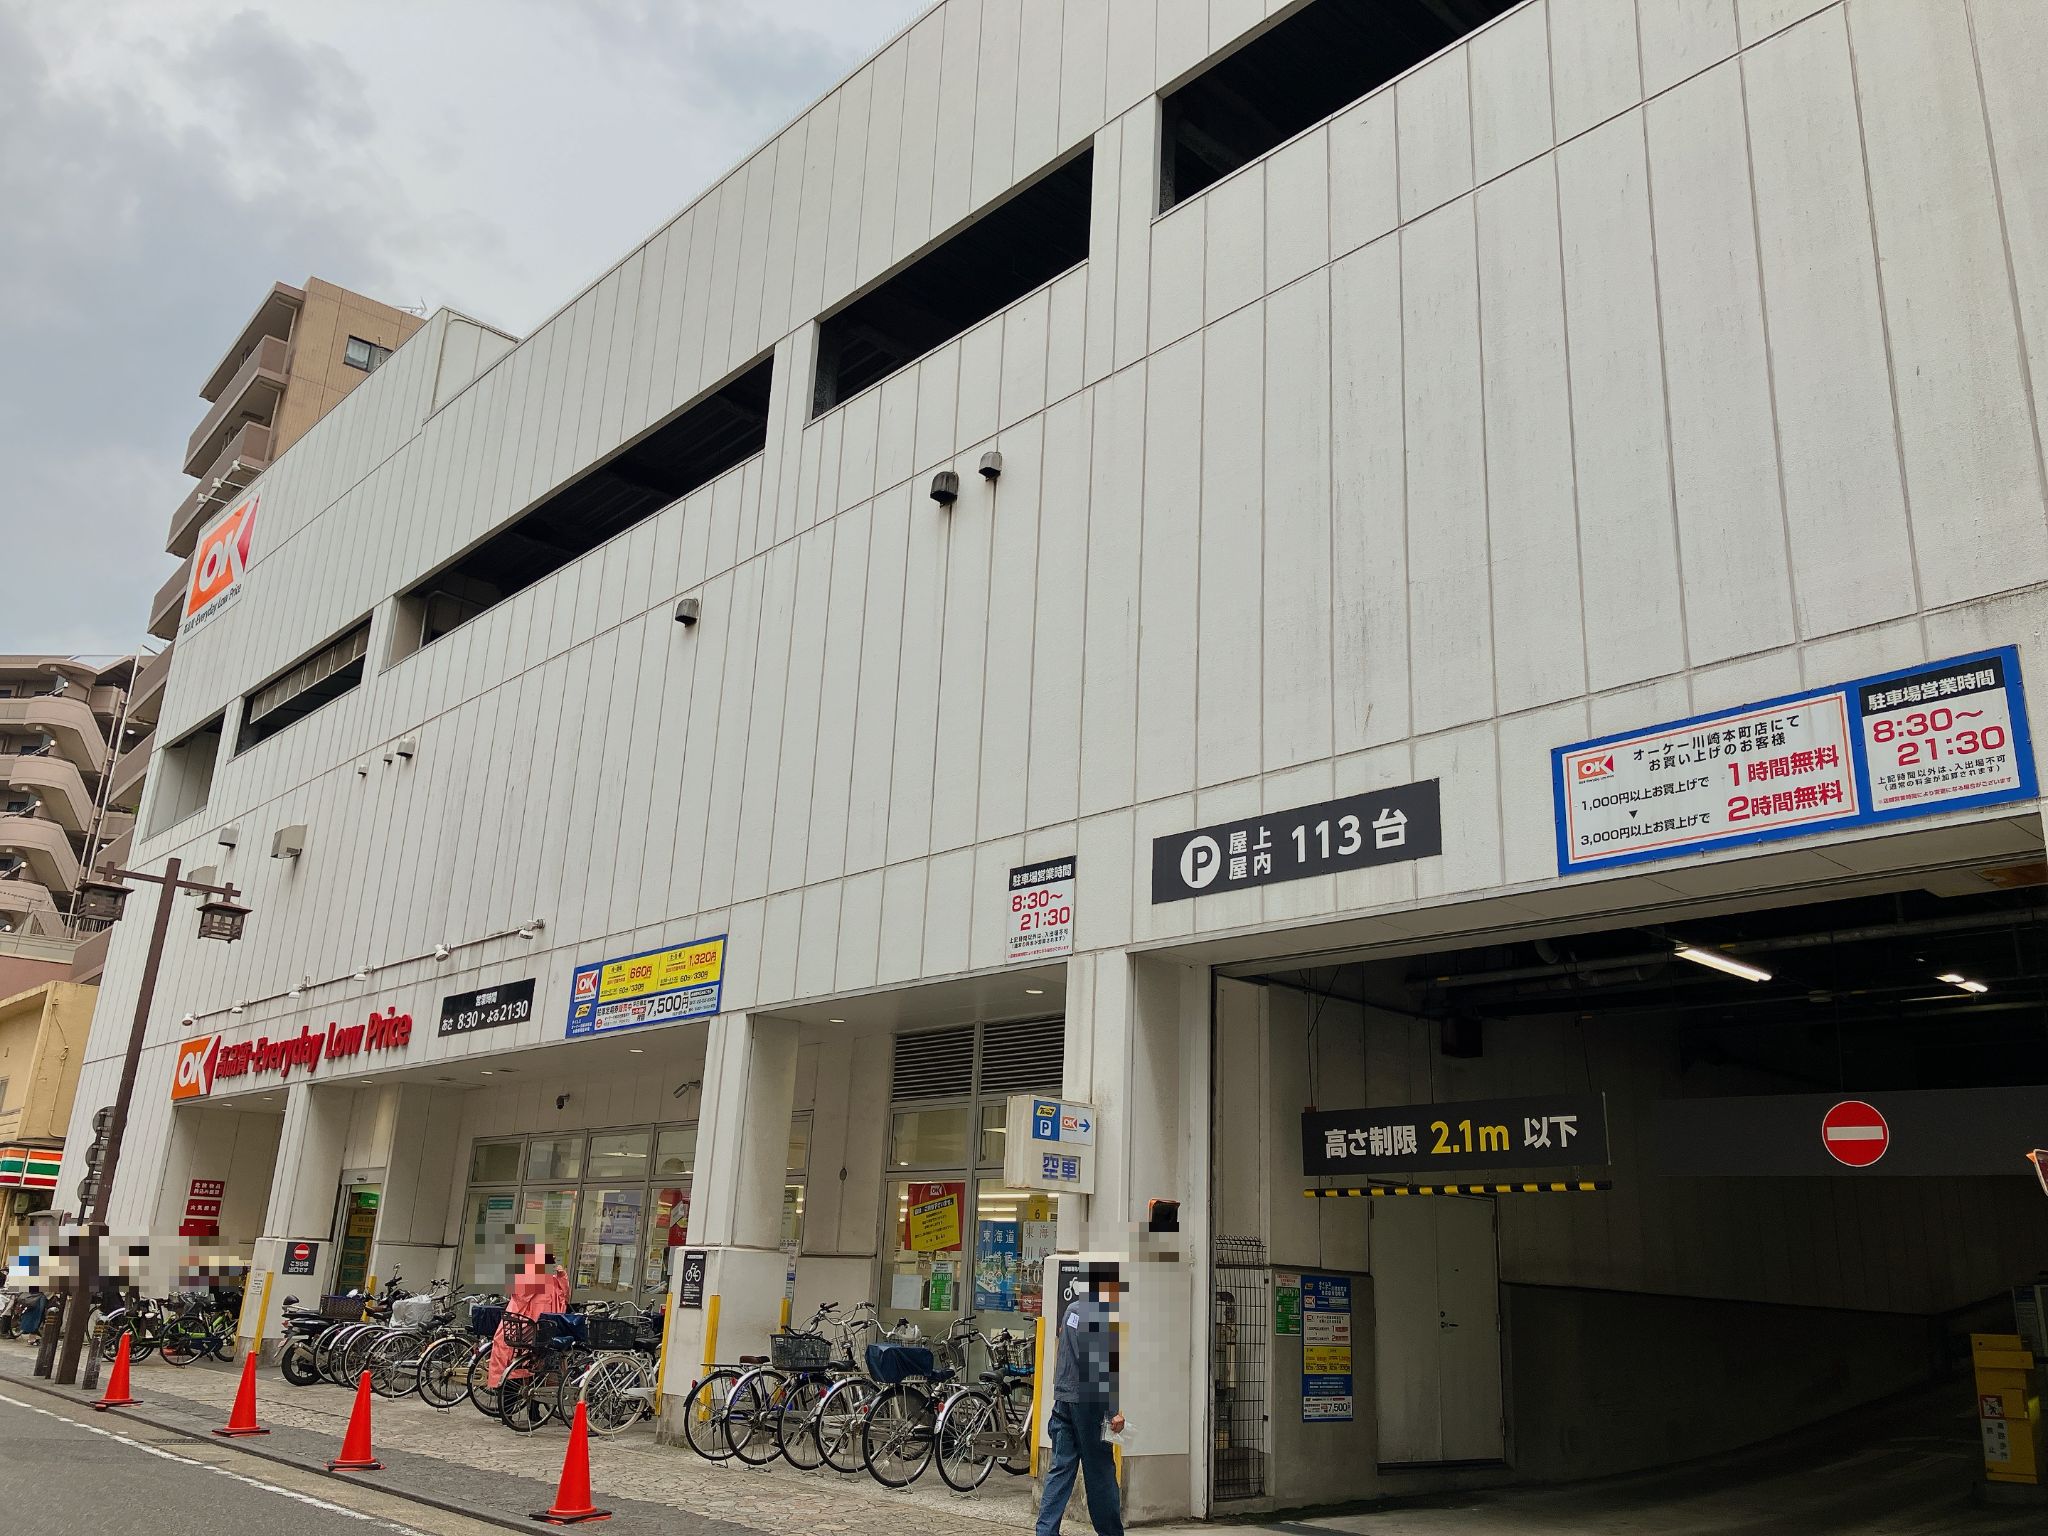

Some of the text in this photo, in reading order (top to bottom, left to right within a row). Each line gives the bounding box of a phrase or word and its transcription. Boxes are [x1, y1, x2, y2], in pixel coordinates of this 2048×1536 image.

[199, 500, 252, 592] OK
[1868, 668, 1996, 711] 駐車場営業時間
[1633, 714, 1800, 761] オーケー川崎本町店にて
[1897, 725, 2005, 767] 21:30
[1581, 755, 1612, 776] OK
[1649, 732, 1786, 772] お買い上げのお客様
[1728, 745, 1839, 787] 1時間無料
[1582, 776, 1709, 811] 1,000円以上お買上げで
[1728, 780, 1843, 822] 2時間無料
[1229, 827, 1272, 855] 屋上
[1580, 812, 1710, 846] 3,000円以上お買上げで
[1012, 863, 1072, 887] 駐車場営業時間
[1229, 853, 1272, 881] 屋内
[1020, 906, 1070, 931] 21:30
[579, 973, 597, 992] OK
[629, 965, 653, 979] 660円
[475, 991, 498, 1007] 営業時間
[647, 995, 689, 1017] 7,500円
[324, 1021, 366, 1060] Low
[364, 1006, 412, 1051] Price
[441, 1018, 453, 1031] あさ
[457, 1011, 479, 1030] 8:30
[178, 1033, 221, 1096] OK
[1042, 1122, 1049, 1133] P
[1063, 1118, 1077, 1129] OK
[1324, 1115, 1578, 1159] 高さ制限 2.1m 以下
[983, 1229, 1015, 1244] 東海道
[1025, 1224, 1057, 1239] 東海
